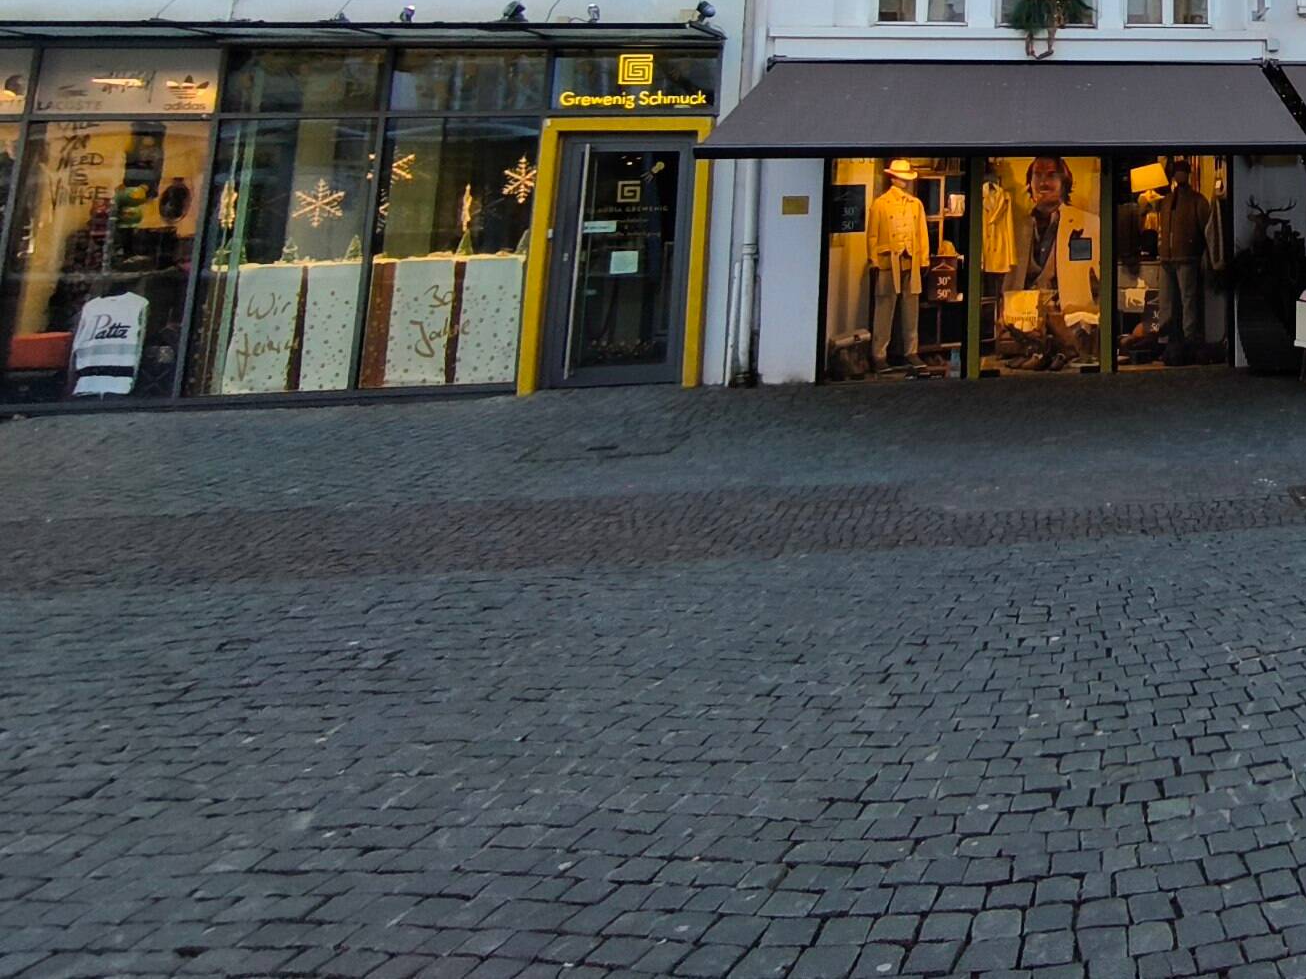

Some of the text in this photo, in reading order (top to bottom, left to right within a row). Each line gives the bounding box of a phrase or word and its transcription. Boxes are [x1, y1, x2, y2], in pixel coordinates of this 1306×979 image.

[163, 100, 207, 112] adidas
[559, 89, 707, 109] Grewenig Schmuck
[246, 291, 292, 320] Wir
